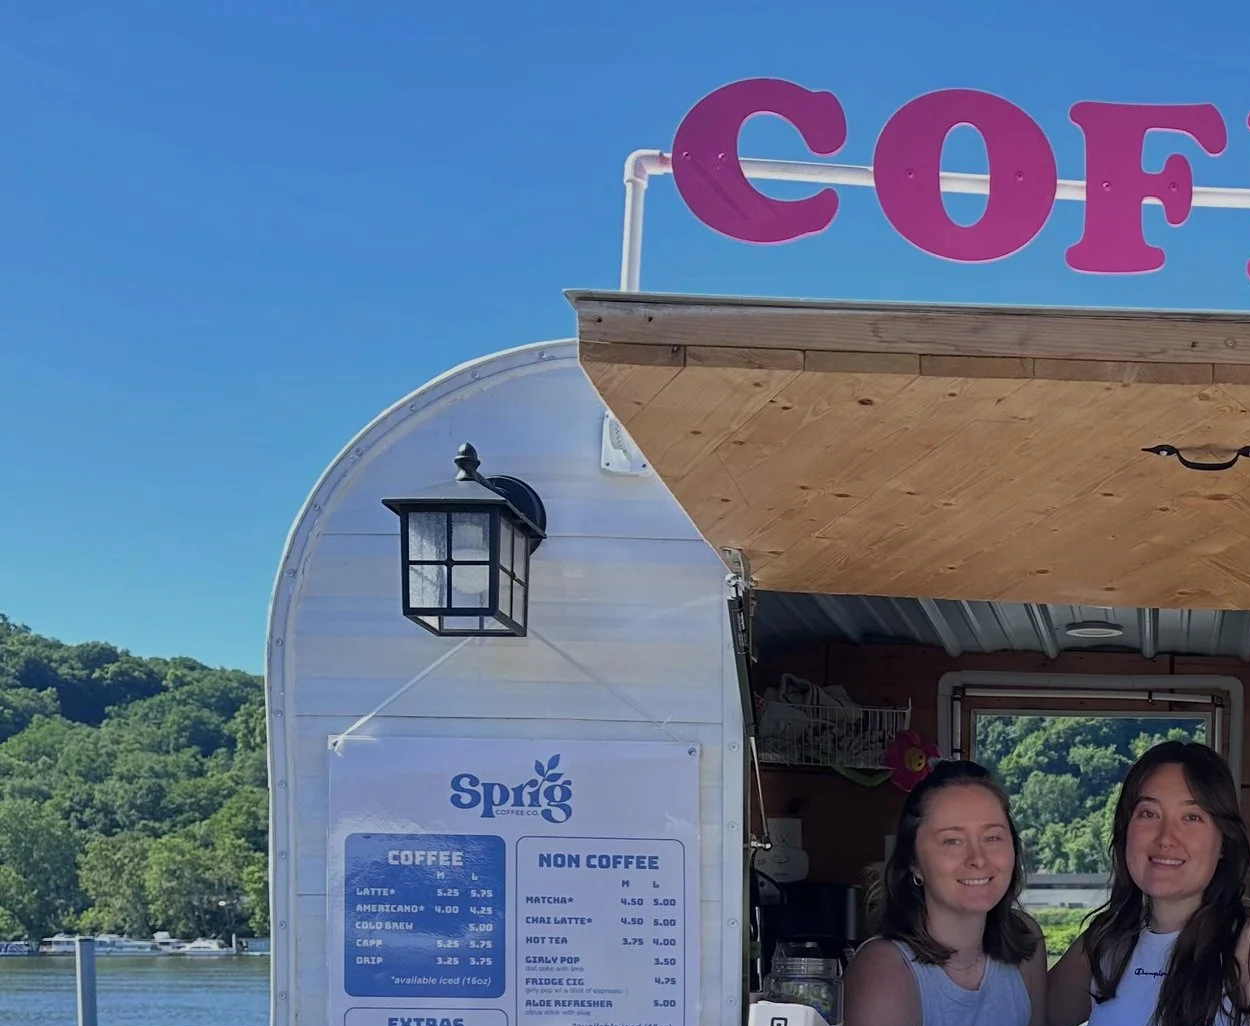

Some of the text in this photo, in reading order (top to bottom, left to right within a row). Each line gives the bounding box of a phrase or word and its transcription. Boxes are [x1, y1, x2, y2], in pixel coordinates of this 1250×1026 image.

[450, 773, 573, 824] Sprig
[388, 850, 464, 866] COFFEE
[538, 853, 660, 870] NON COFFEE
[436, 871, 445, 880] M
[622, 880, 630, 888] M
[436, 889, 460, 897] 5.25
[470, 889, 493, 898] 5.75
[621, 898, 644, 906] 4.50
[653, 898, 676, 907] 5.00
[434, 905, 460, 914] 4.00
[469, 906, 493, 915] 4.25
[355, 921, 493, 932] COLD BREW 5.00
[525, 916, 551, 925] CHAI
[653, 919, 676, 927] 5.00
[356, 939, 492, 948] CAPP 5.25 5.75
[525, 936, 676, 946] HOT TEA 3.75 4.00
[356, 956, 492, 966] DRIP 3.25 3.75
[525, 956, 676, 966] GIRLY POP 3.50
[439, 976, 460, 985] iced
[462, 976, 492, 987] (16oz)
[525, 977, 676, 986] FRIDGE CIG 4.75
[554, 1000, 613, 1008] REFRESHER
